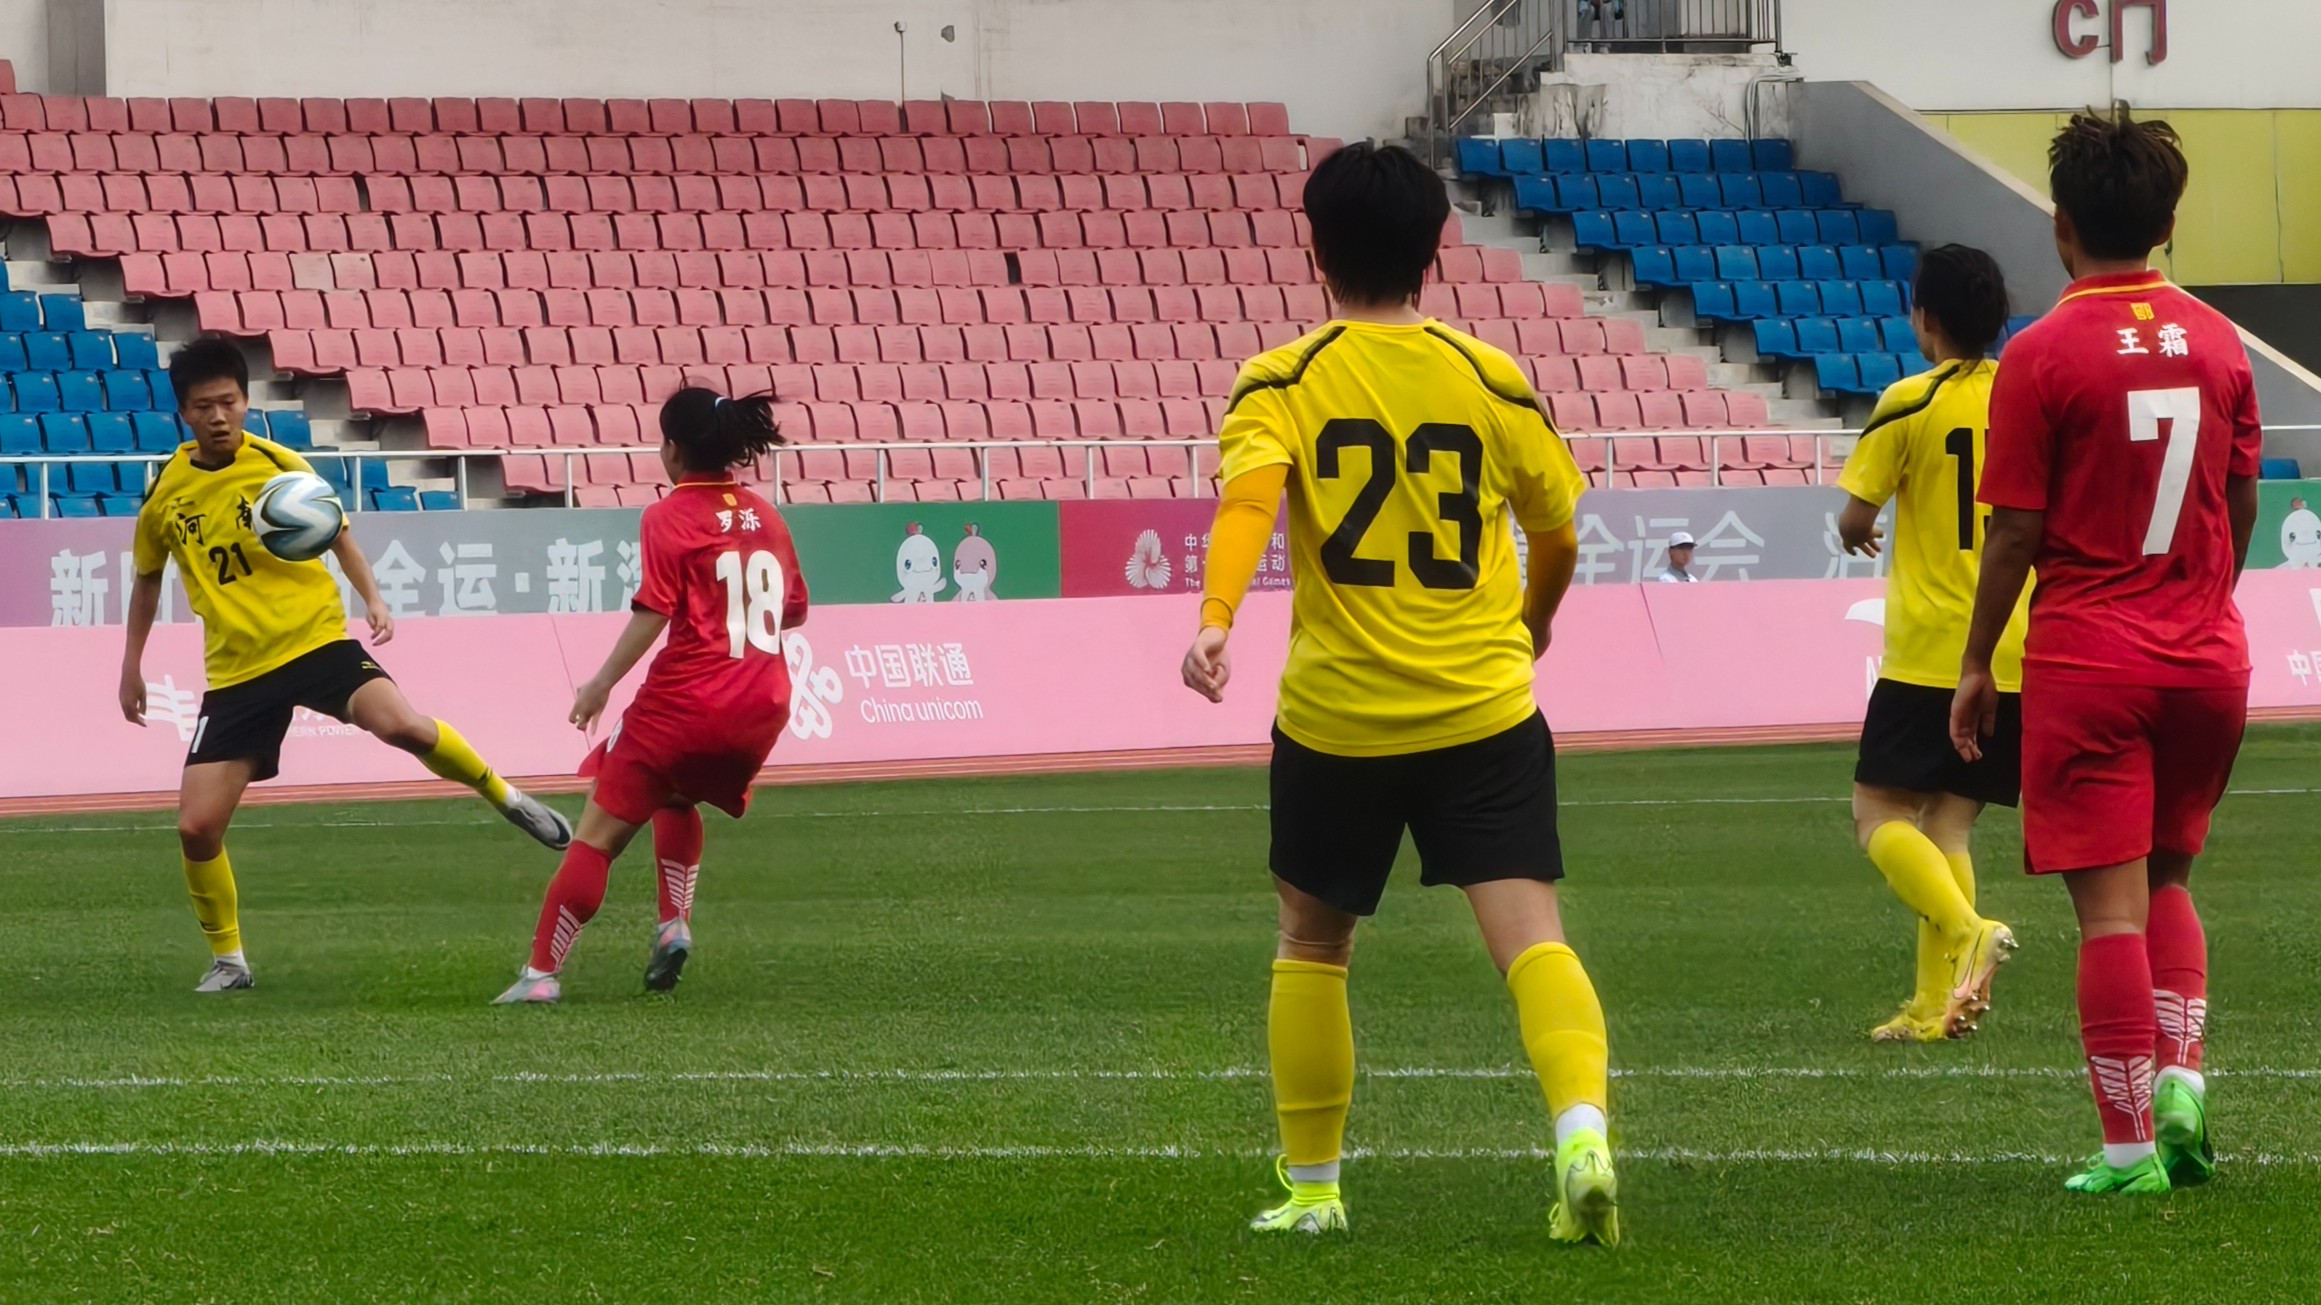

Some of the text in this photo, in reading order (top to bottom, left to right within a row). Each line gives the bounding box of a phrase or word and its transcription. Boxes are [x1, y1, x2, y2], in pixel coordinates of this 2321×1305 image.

[2116, 323, 2189, 357] 王霜
[1316, 418, 1484, 590] 23
[1945, 427, 1992, 551] 1
[2127, 387, 2200, 556] 7
[208, 542, 252, 585] 21
[716, 549, 784, 659] 18
[845, 643, 974, 689] 中国联通
[860, 696, 984, 723] China unicom
